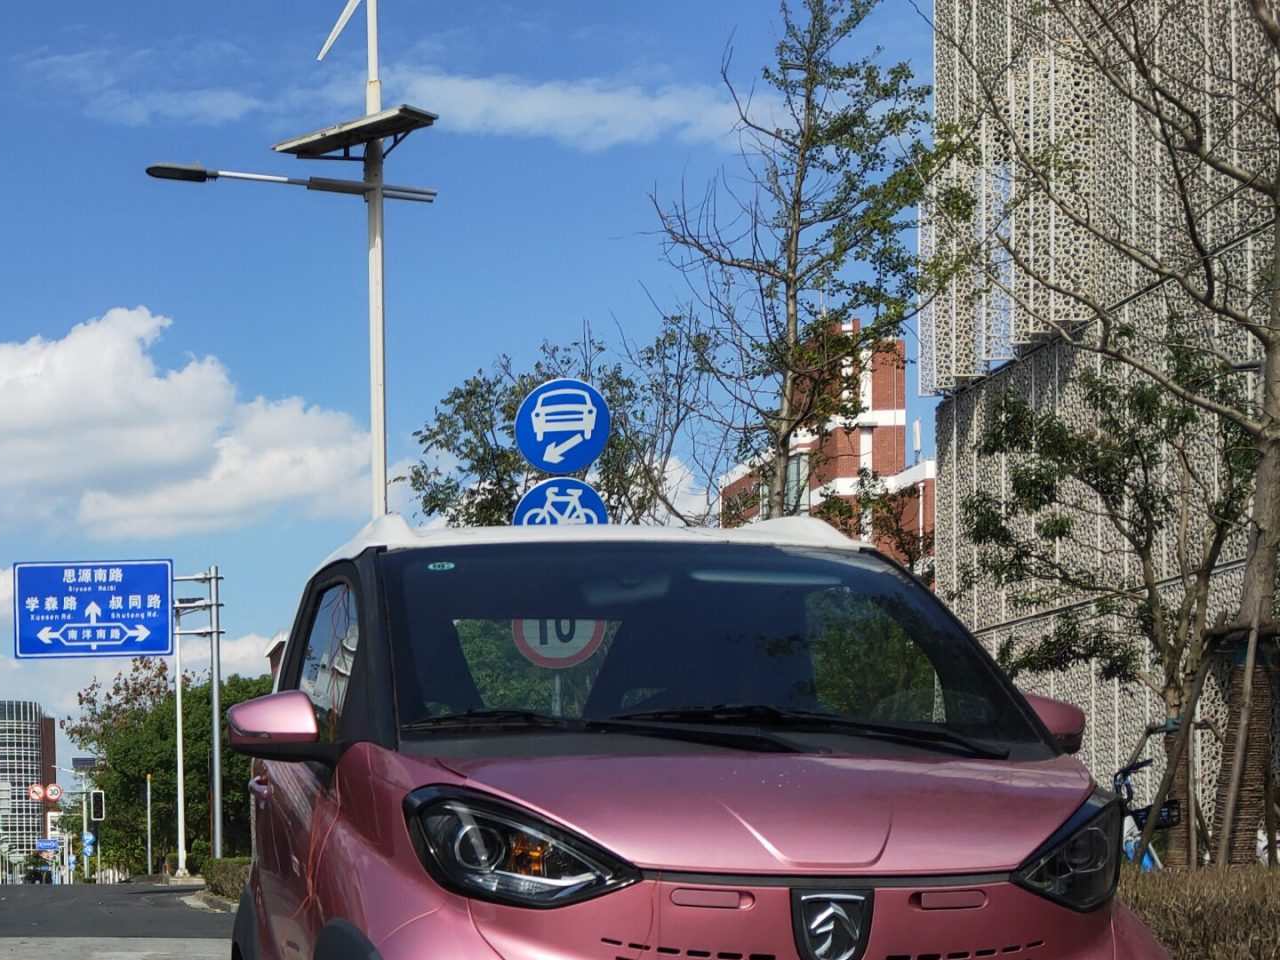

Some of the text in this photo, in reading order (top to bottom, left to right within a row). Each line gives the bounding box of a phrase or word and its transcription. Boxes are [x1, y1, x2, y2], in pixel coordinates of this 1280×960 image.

[63, 568, 123, 583] 思源南路
[25, 596, 77, 612] 学森路
[109, 594, 161, 610] 叔同路
[111, 612, 145, 621] Shutong
[67, 628, 120, 640] 南洋南路
[49, 788, 59, 796] 30
